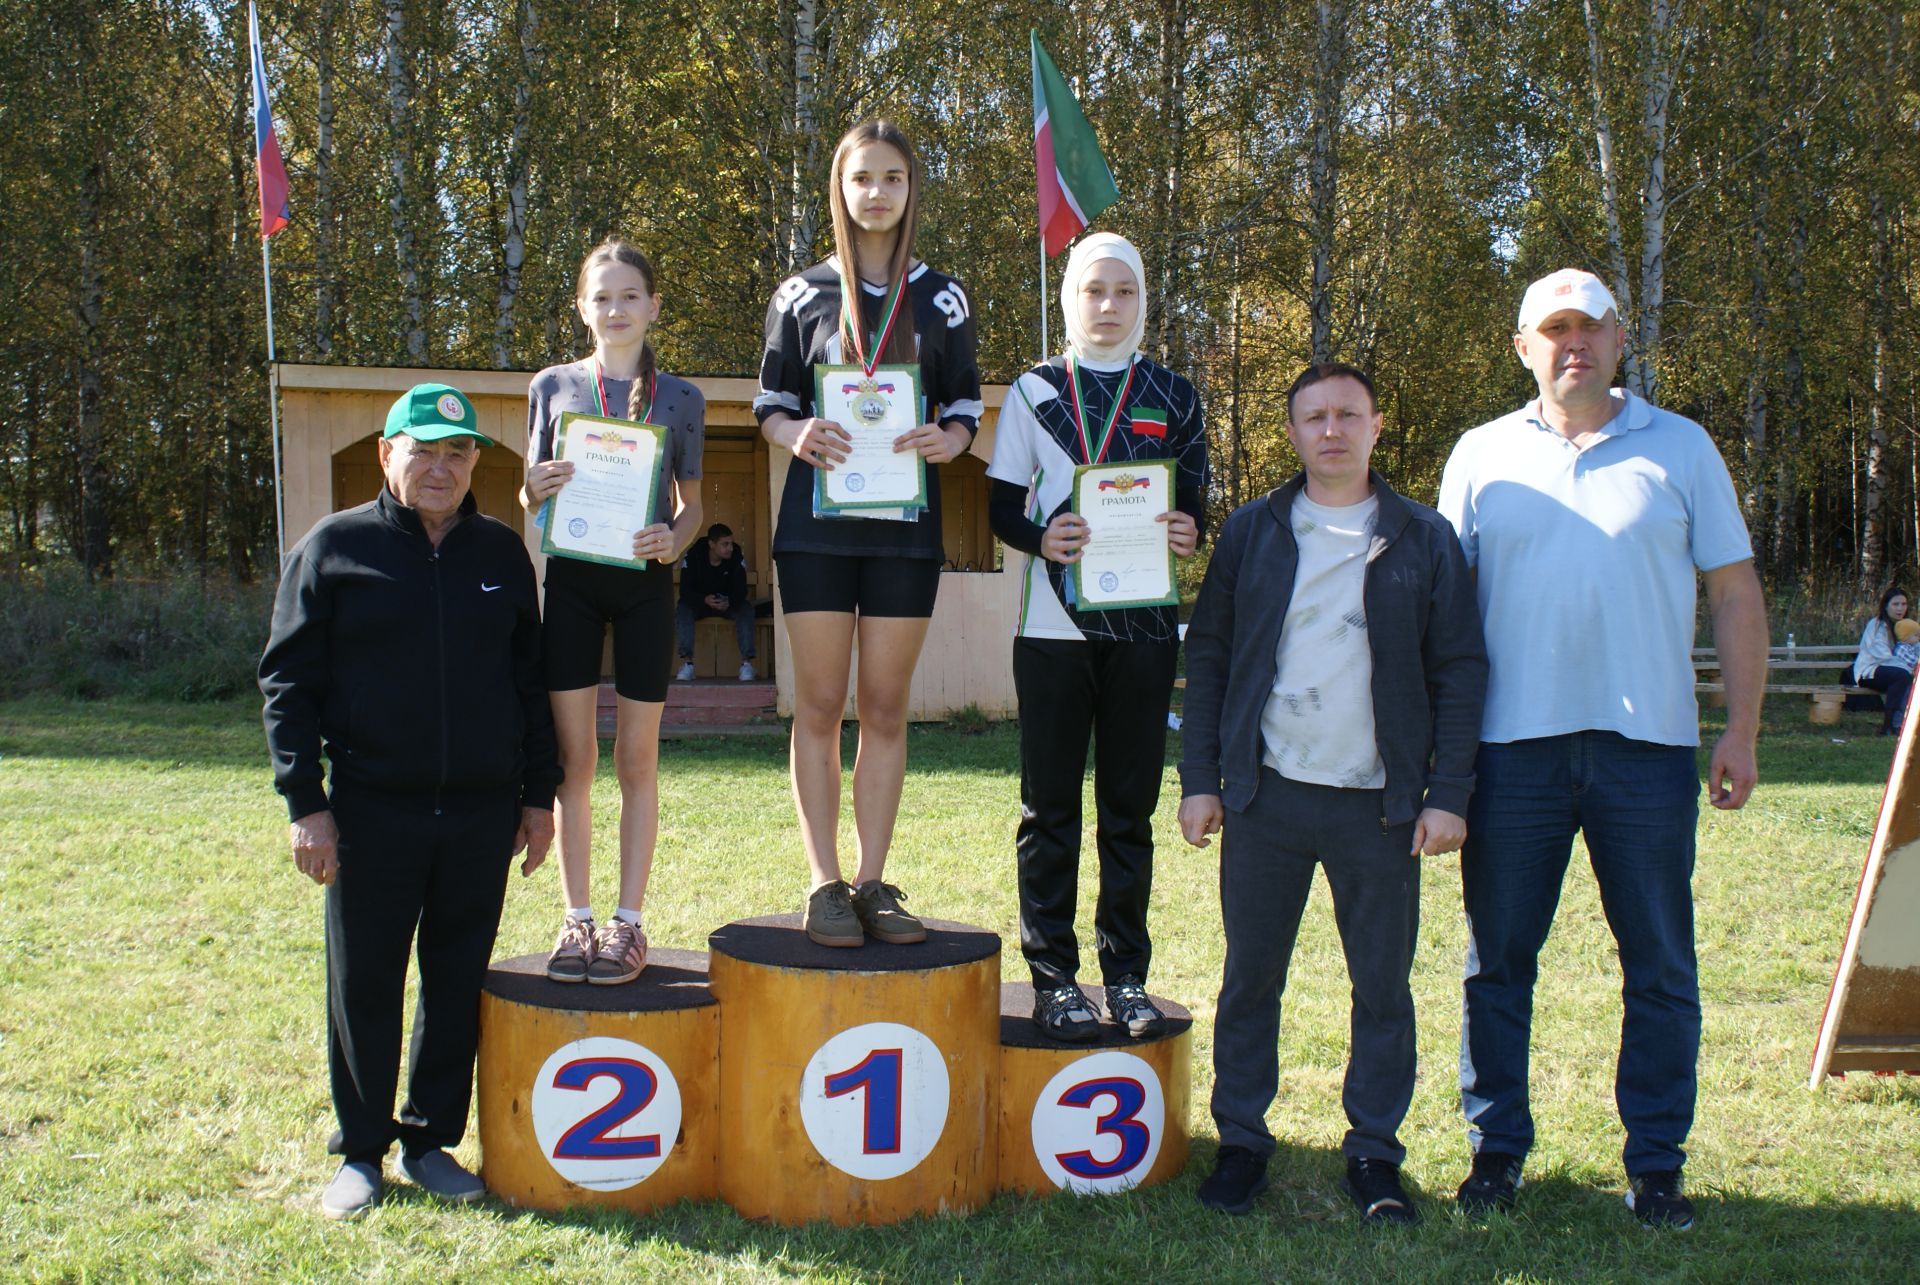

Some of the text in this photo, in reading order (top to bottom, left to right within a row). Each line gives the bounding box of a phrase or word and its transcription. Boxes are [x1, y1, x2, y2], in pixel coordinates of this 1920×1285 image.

[586, 452, 631, 465] ГРАМОТА
[1102, 496, 1146, 505] ГРАМОТА
[552, 1056, 661, 1159] 2
[825, 1048, 903, 1155] 1
[1056, 1077, 1151, 1179] 3
